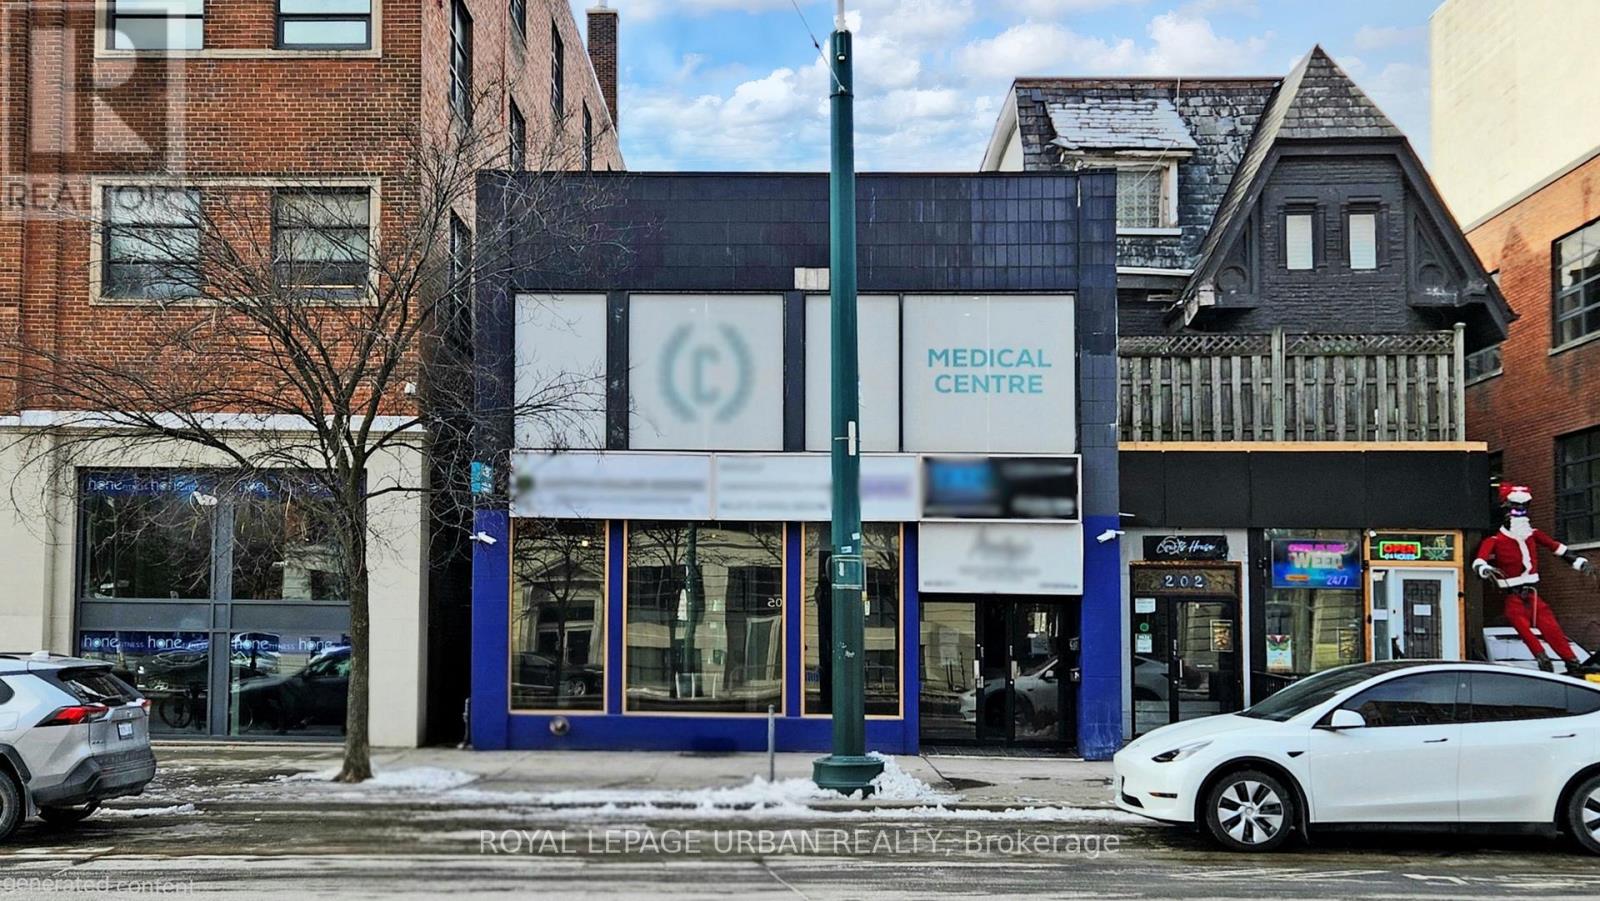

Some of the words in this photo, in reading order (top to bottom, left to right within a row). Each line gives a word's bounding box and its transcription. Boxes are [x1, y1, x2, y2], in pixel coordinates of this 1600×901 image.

[927, 348, 1052, 368] MEDICAL
[934, 374, 1043, 394] CENTRE
[1384, 544, 1417, 554] OPEN
[1165, 574, 1204, 588] 202
[1326, 575, 1349, 586] 24/7
[84, 635, 119, 649] hone
[147, 635, 182, 649] hone
[234, 638, 269, 650] hone
[298, 637, 333, 650] hone
